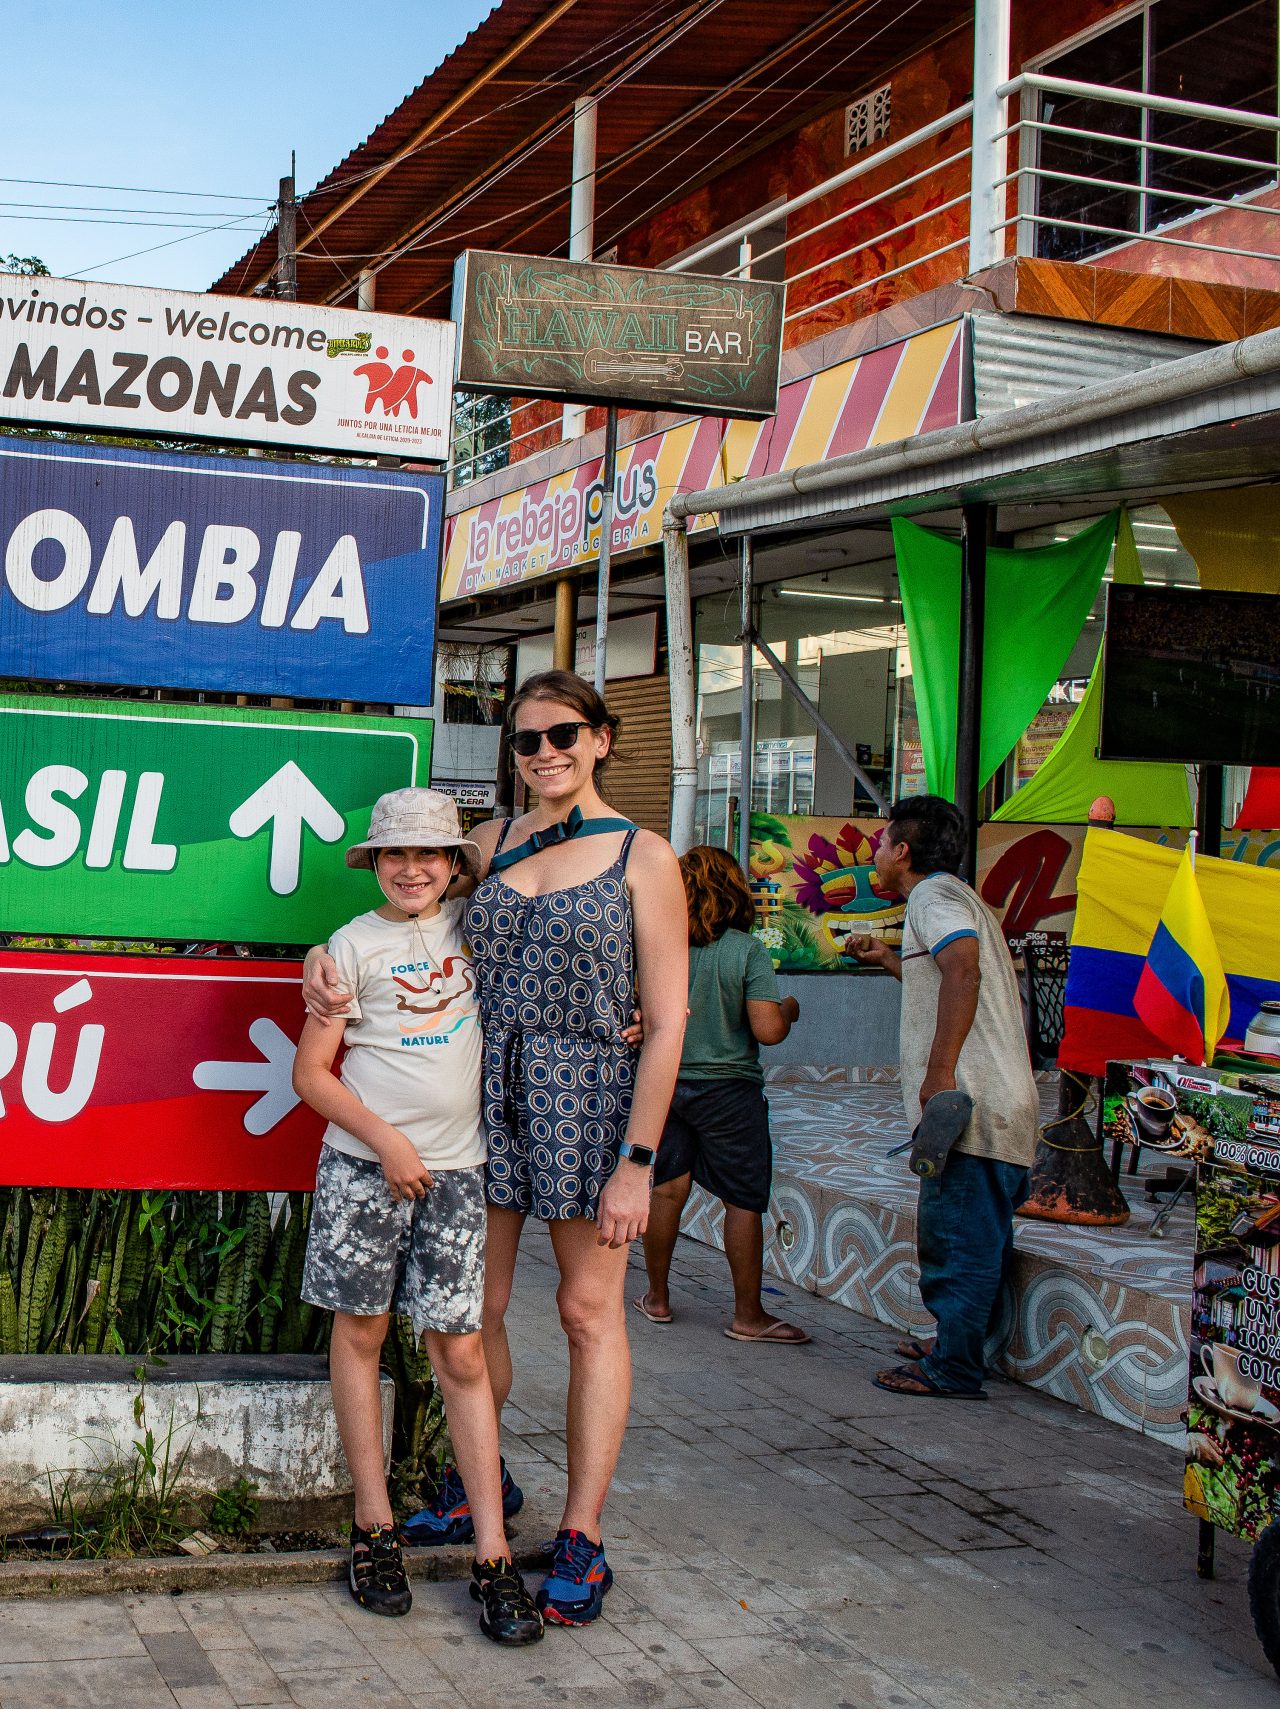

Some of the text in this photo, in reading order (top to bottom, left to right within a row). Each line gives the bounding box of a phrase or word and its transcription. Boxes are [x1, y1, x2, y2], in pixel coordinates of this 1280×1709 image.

[164, 307, 327, 353] Welcome
[504, 307, 743, 355] HAWAII BAR
[337, 418, 443, 438] JUNTOS POR UNA LETICIA MEJOR
[465, 525, 650, 590] MINIMARKET DROGERIA
[461, 789, 490, 798] OSCAR
[1009, 938, 1028, 947] QUE
[1025, 932, 1048, 940] SIGA
[390, 962, 430, 975] FORCE
[401, 1035, 450, 1047] NATURE
[1216, 1140, 1247, 1163] 100%
[1245, 1296, 1274, 1328] UN
